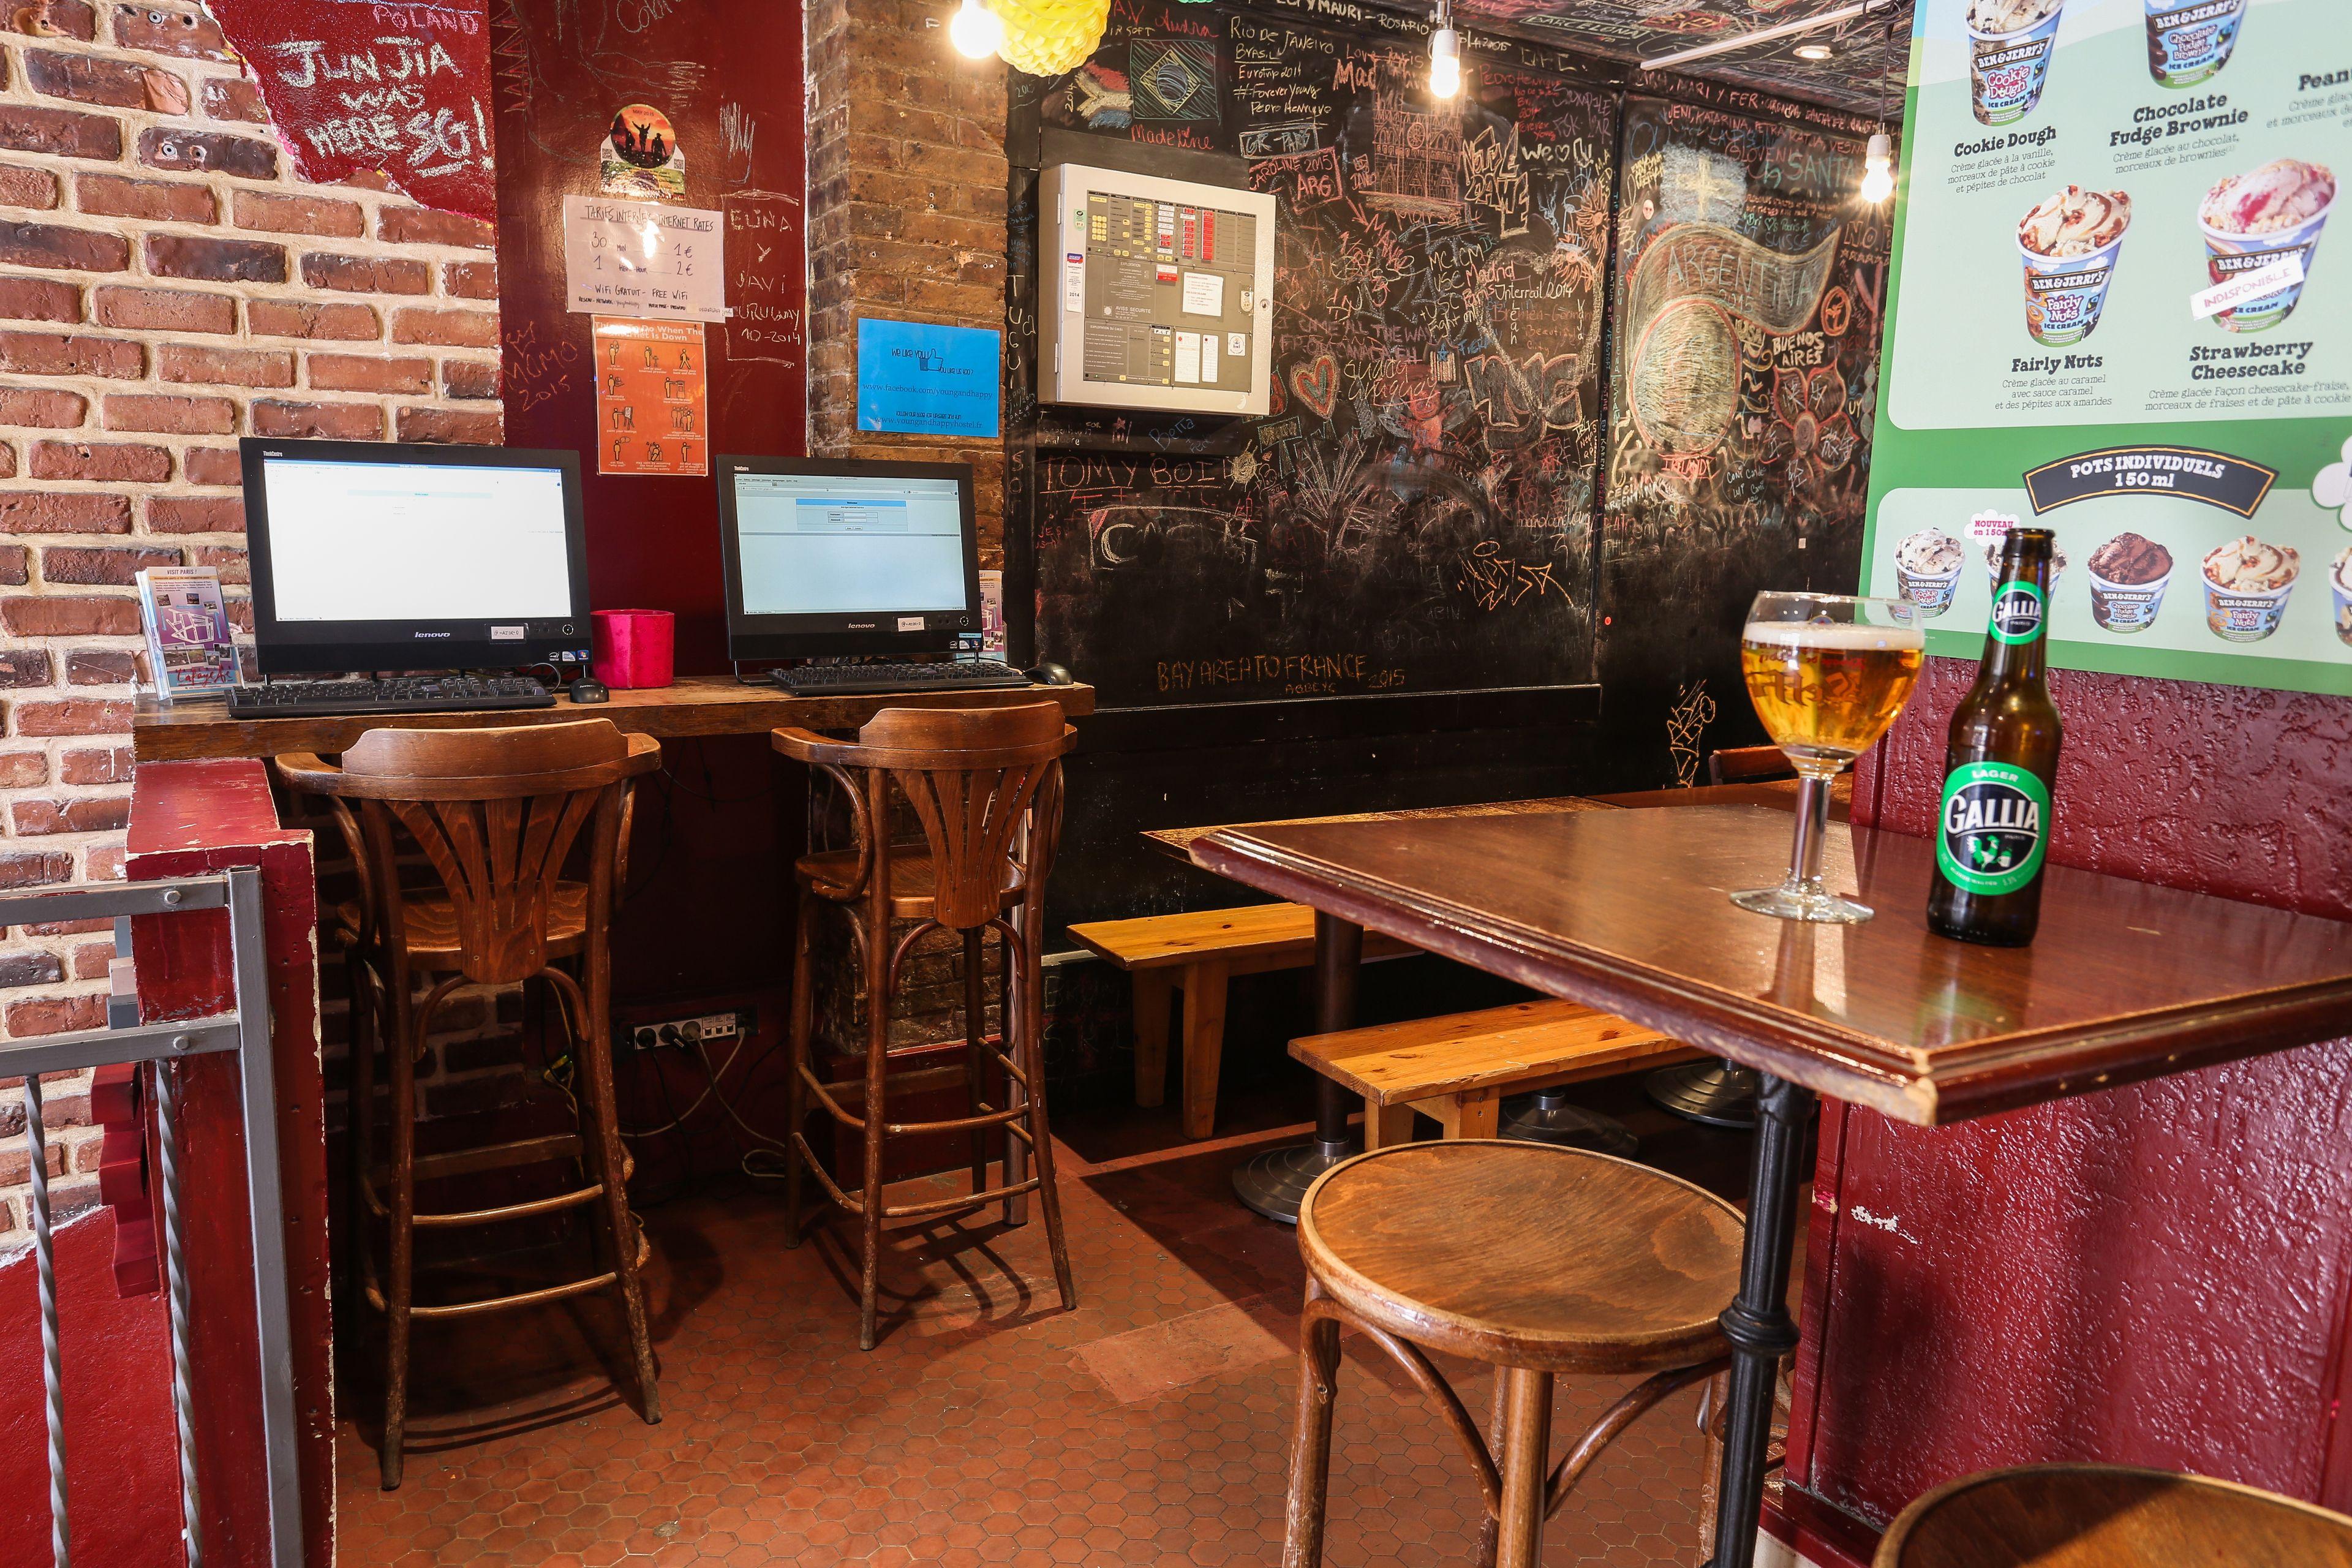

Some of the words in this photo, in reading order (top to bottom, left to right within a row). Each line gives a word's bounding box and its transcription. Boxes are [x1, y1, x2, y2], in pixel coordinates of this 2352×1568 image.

[1988, 65, 2030, 86] Cookie
[1989, 80, 2027, 99] Dough
[2133, 94, 2228, 123] Chocolate
[2109, 125, 2162, 147] Fudge
[2166, 108, 2249, 137] Brownie
[1954, 136, 2004, 157] Cookie
[2007, 126, 2057, 148] Dough
[2113, 150, 2143, 164] Crème
[2144, 144, 2175, 159] glacée
[2177, 142, 2190, 152] au
[2192, 133, 2240, 149] chocolat,
[1947, 172, 1986, 184] morceaux
[1988, 168, 1998, 178] de
[2000, 164, 2019, 177] pâte
[2020, 164, 2026, 173] à
[2027, 159, 2056, 172] cookie
[1951, 161, 1976, 174] Crème
[1977, 157, 2002, 170] glacée
[2004, 155, 2009, 164] à
[2011, 153, 2019, 162] la
[2022, 148, 2054, 161] vanille,
[2115, 158, 2162, 175] morceaux
[2164, 154, 2176, 166] de
[1966, 180, 1996, 194] pépites
[1997, 177, 2007, 186] de
[2009, 172, 2046, 185] chocolat
[693, 217, 713, 232] RATES
[591, 231, 607, 247] 30
[684, 245, 692, 258] €
[685, 263, 693, 276] €
[652, 288, 668, 298] FREE
[2204, 267, 2291, 308] INDISPONIBLE
[2046, 295, 2084, 312] Fairly
[2050, 308, 2079, 323] Nuts
[662, 333, 687, 341] Down
[686, 327, 704, 336] The
[1772, 331, 1825, 356] BUENOS
[2188, 340, 2314, 362] Strawberry
[2011, 355, 2062, 375] Fairly
[2064, 353, 2103, 370] Nuts
[2191, 360, 2305, 380] Cheesecake
[862, 383, 993, 400] www.facebook.com/youngandhappy
[2002, 379, 2029, 389] Crème
[2030, 377, 2057, 390] glacée
[2059, 377, 2069, 386] au
[2071, 374, 2107, 385] caramel
[2032, 389, 2057, 398] sauce
[2059, 386, 2094, 397] caramel
[2148, 388, 2179, 399] Crème
[2181, 386, 2212, 399] glacée
[2215, 386, 2245, 398] Façon
[1994, 402, 2003, 410] et
[2005, 399, 2020, 410] des
[2021, 398, 2053, 411] pépites
[2054, 399, 2071, 408] aux
[2073, 396, 2113, 407] amandes
[2145, 401, 2192, 411] morceaux
[2194, 398, 2207, 409] de
[2209, 398, 2244, 409] fraises
[2247, 397, 2259, 407] et
[2261, 396, 2275, 406] de
[2277, 395, 2302, 409] pâte
[2313, 393, 2352, 404] cookie
[2070, 458, 2113, 478] POTS
[2115, 455, 2226, 479] INDIVIDUELS
[2115, 472, 2149, 488] 150
[2152, 473, 2174, 488] ml
[1992, 600, 2043, 623] GALLIA
[1284, 654, 1366, 679] FRANCE
[1972, 769, 2019, 783] LAGER
[1944, 794, 2040, 834] GALLIA
